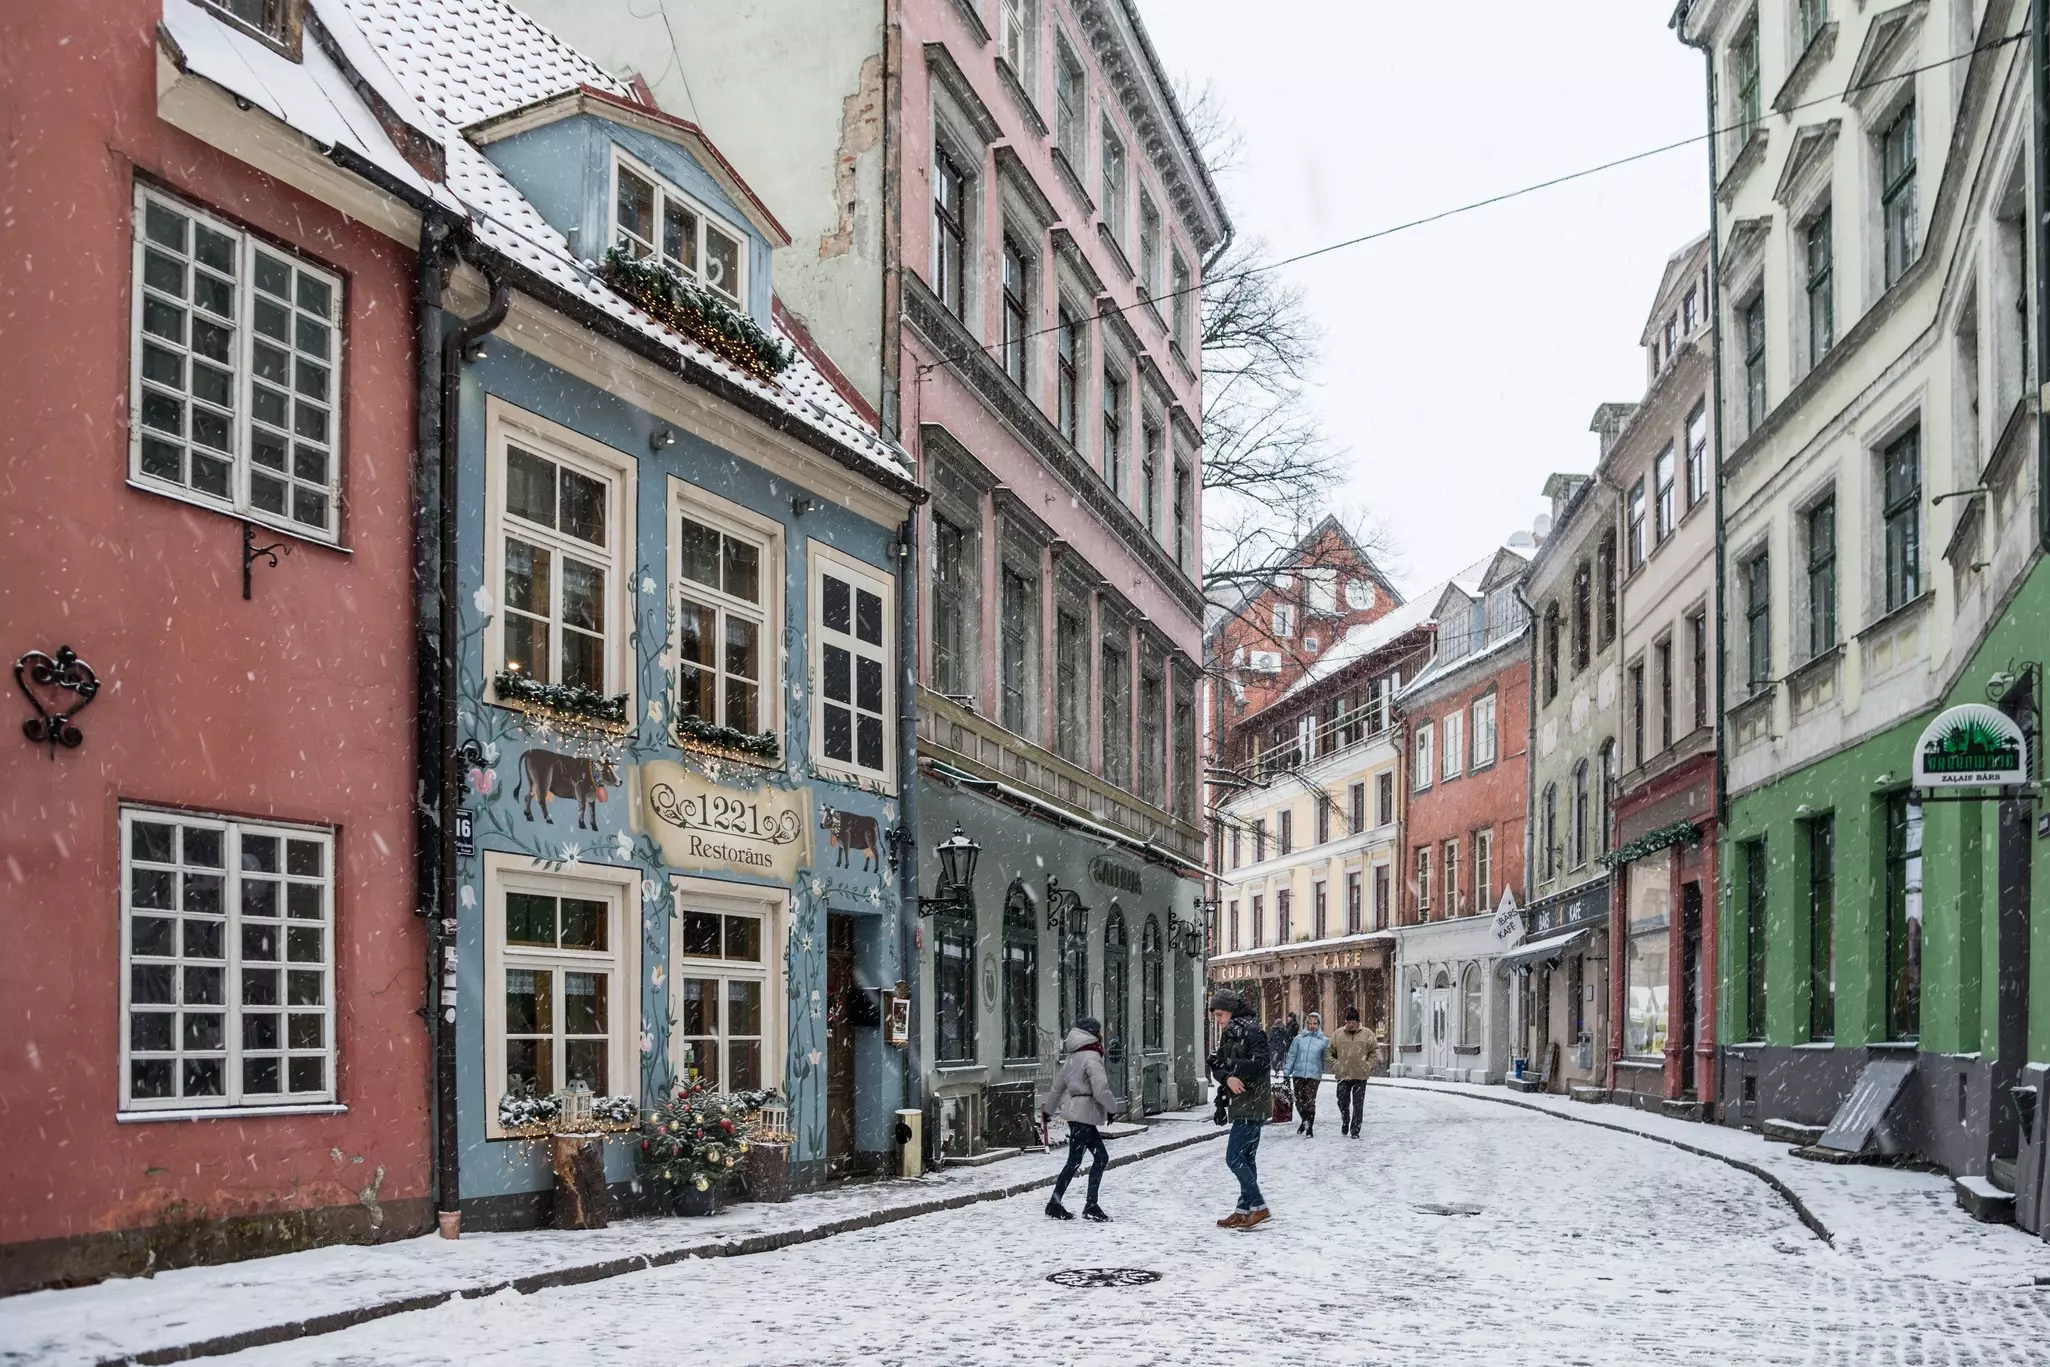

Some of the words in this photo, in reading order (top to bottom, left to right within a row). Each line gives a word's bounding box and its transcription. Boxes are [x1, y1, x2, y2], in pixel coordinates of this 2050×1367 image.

[456, 818, 471, 837] 16
[697, 793, 762, 835] 1221
[688, 834, 773, 868] Restorāns
[1497, 908, 1519, 926] BĀRS
[1222, 964, 1252, 980] CUBA
[1323, 951, 1361, 969] CAFE
